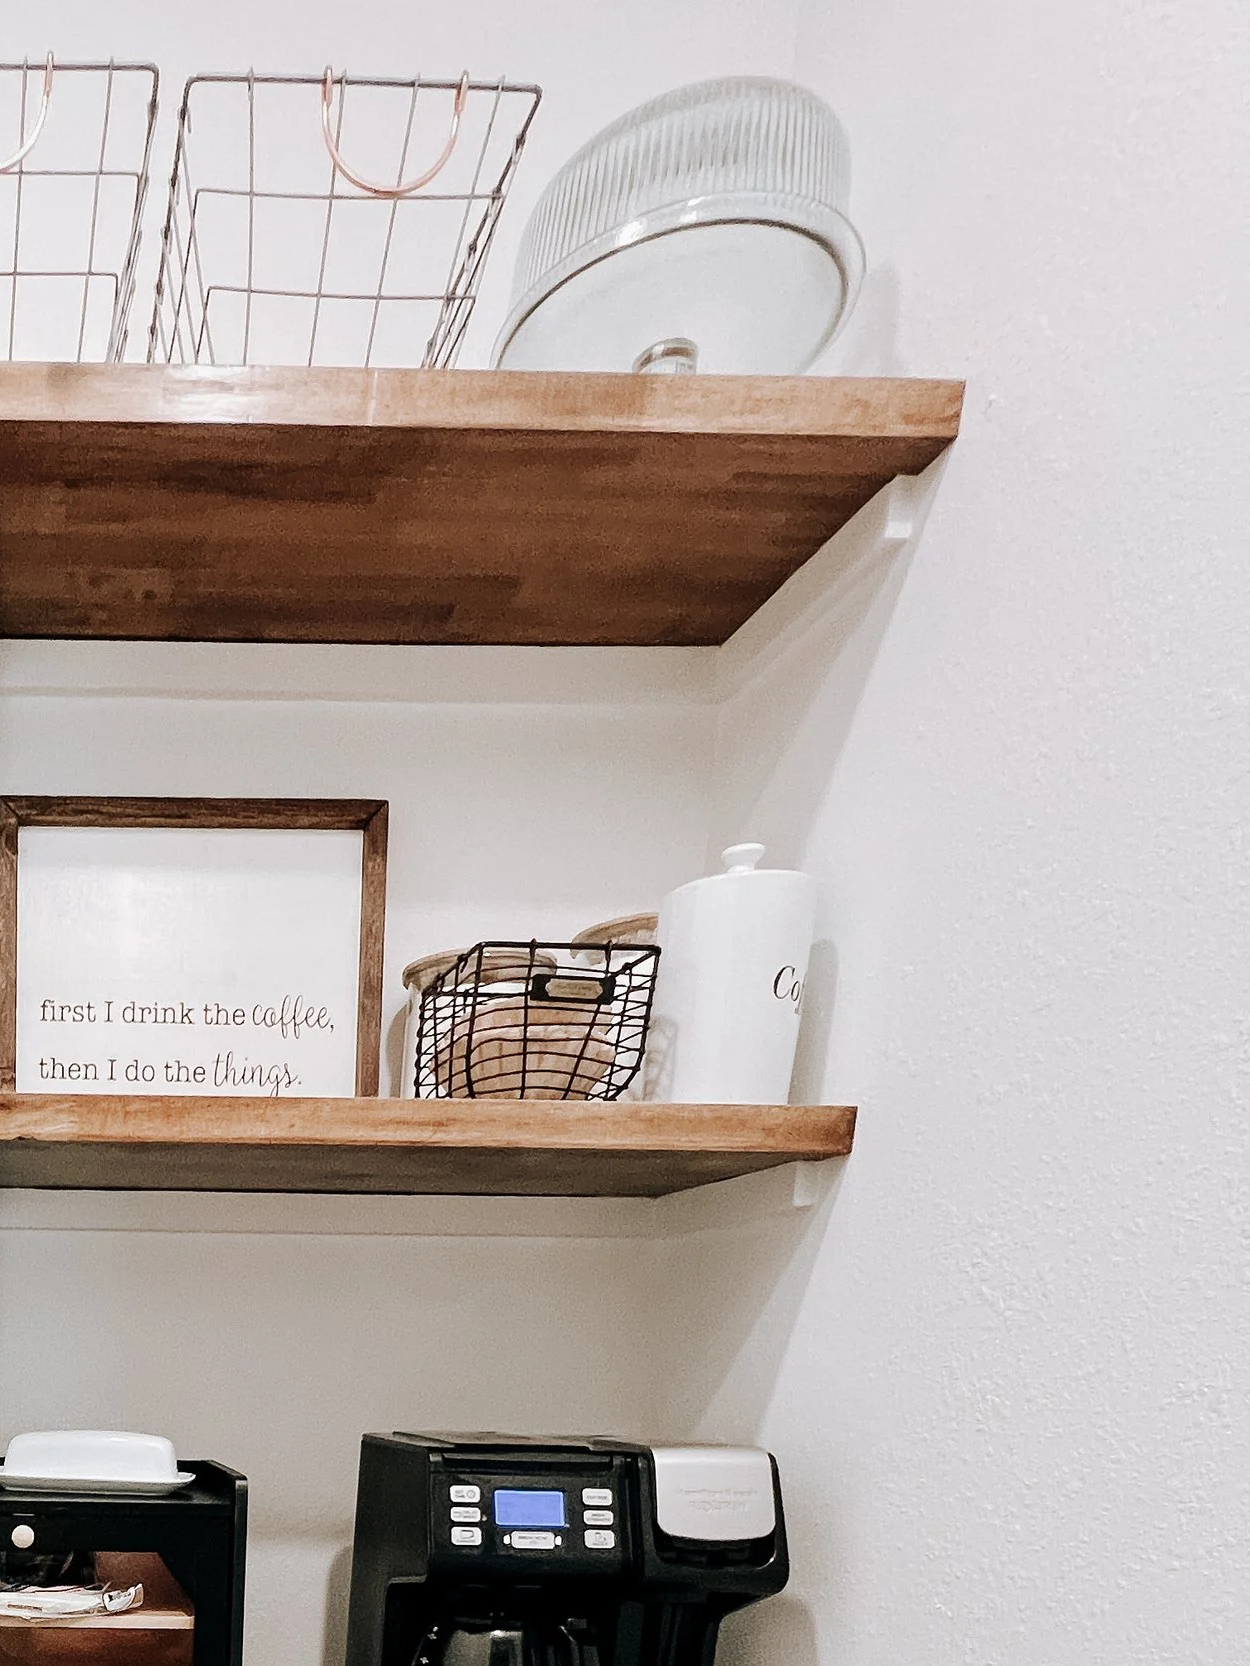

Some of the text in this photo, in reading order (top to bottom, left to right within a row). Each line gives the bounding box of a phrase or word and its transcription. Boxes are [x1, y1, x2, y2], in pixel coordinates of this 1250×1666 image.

[39, 994, 335, 1040] first I drink the coffee,
[38, 1050, 302, 1097] then I do the things.
